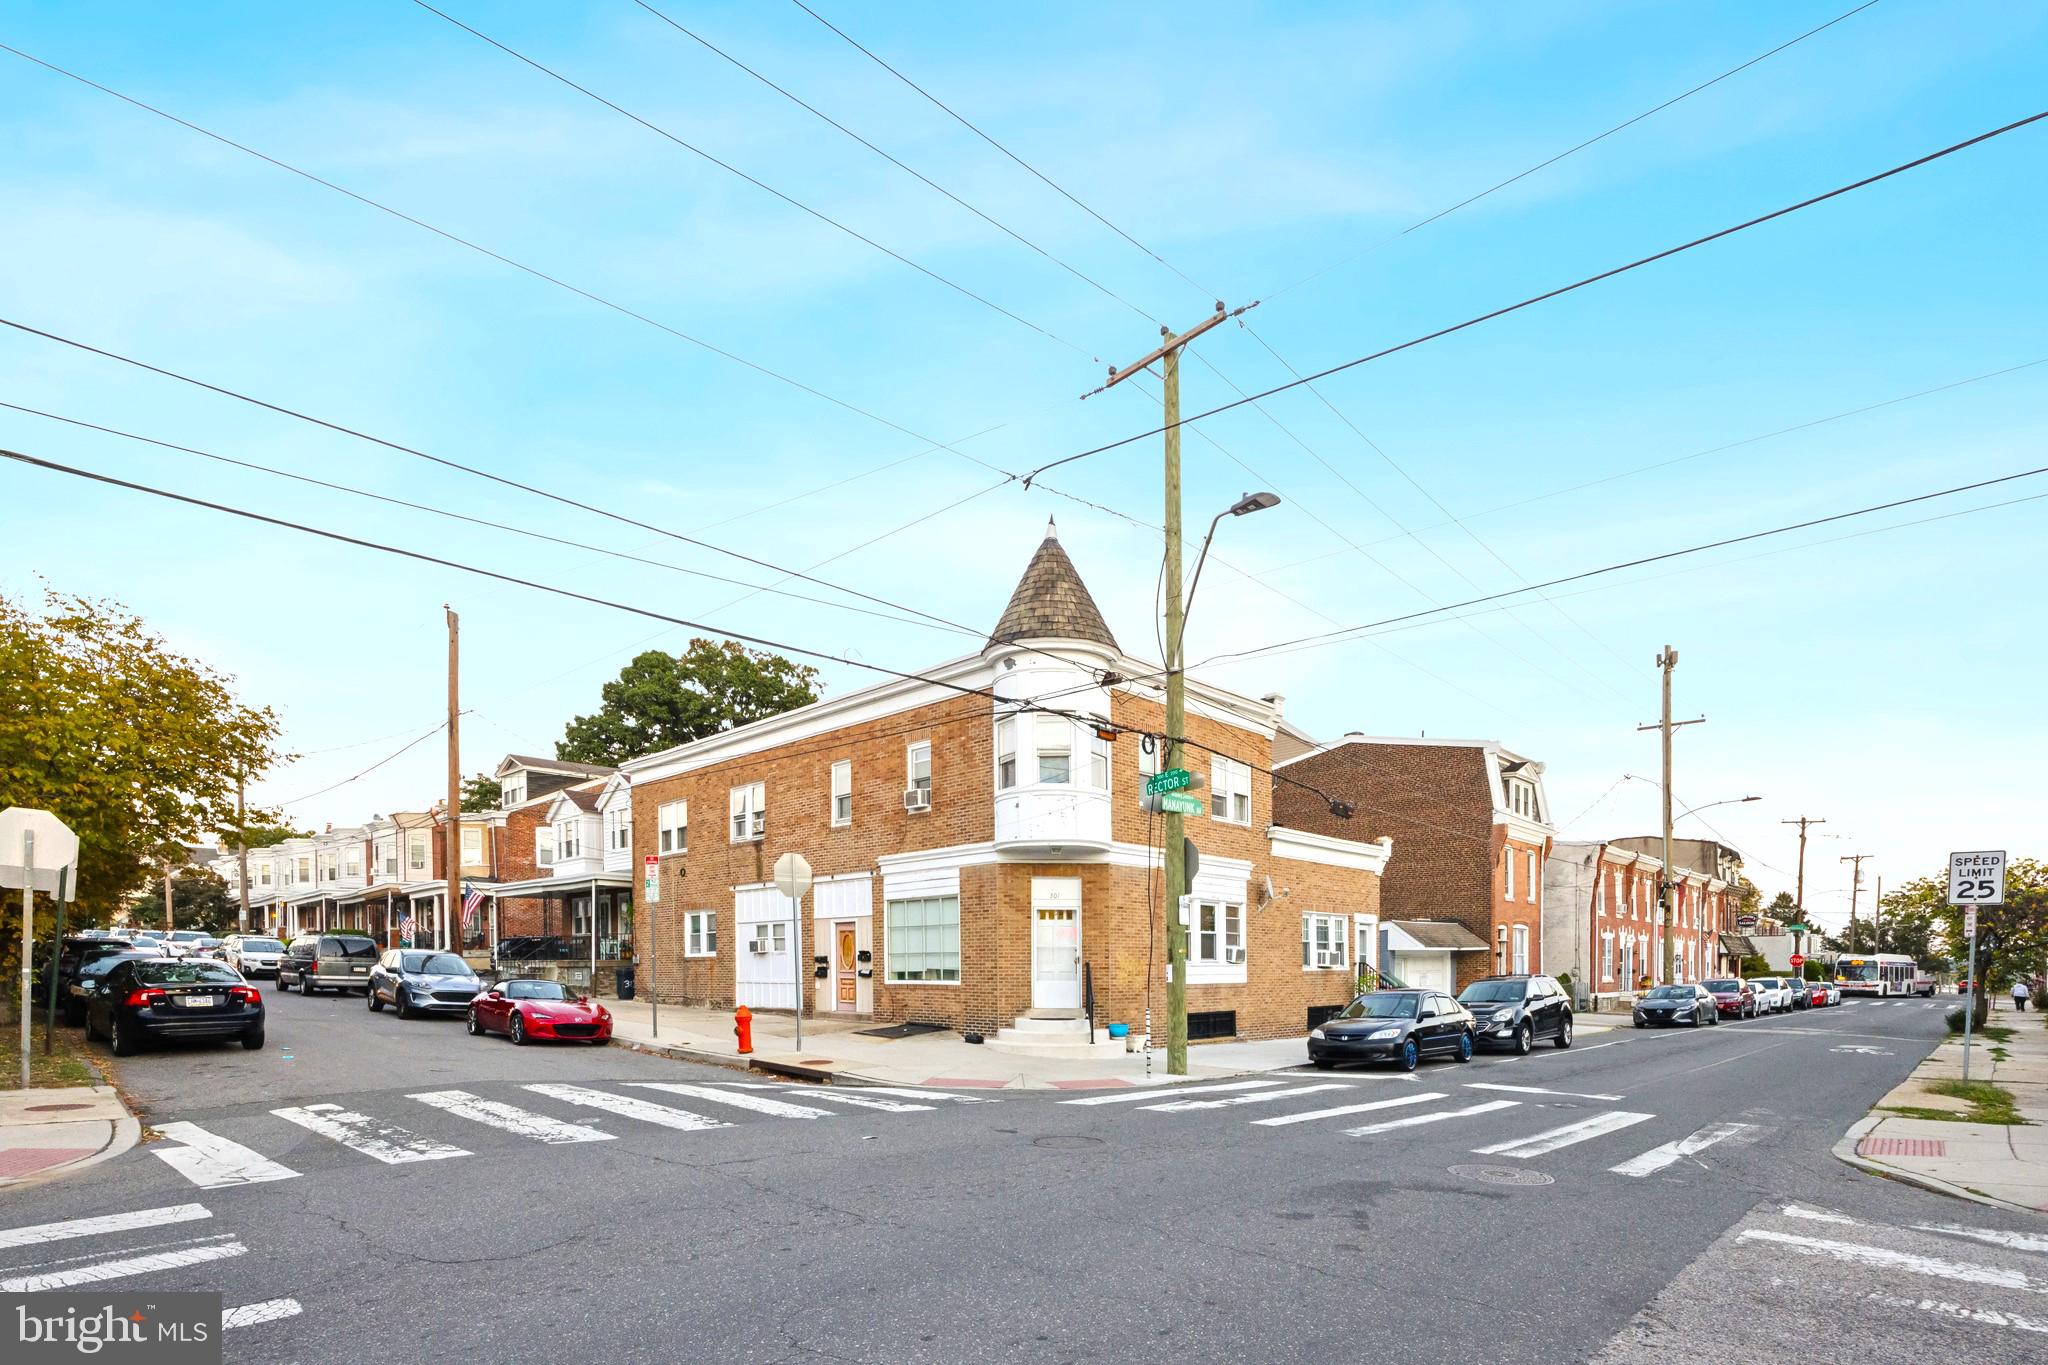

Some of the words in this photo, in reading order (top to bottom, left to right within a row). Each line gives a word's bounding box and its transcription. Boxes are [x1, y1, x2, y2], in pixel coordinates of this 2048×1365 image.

[1147, 777, 1179, 795] RECTOR
[1182, 777, 1188, 785] ST
[1162, 799, 1195, 813] MANAYUNK
[1955, 856, 2000, 867] SPEED
[1959, 868, 1995, 878] LIMIT
[1957, 880, 1996, 899] 25
